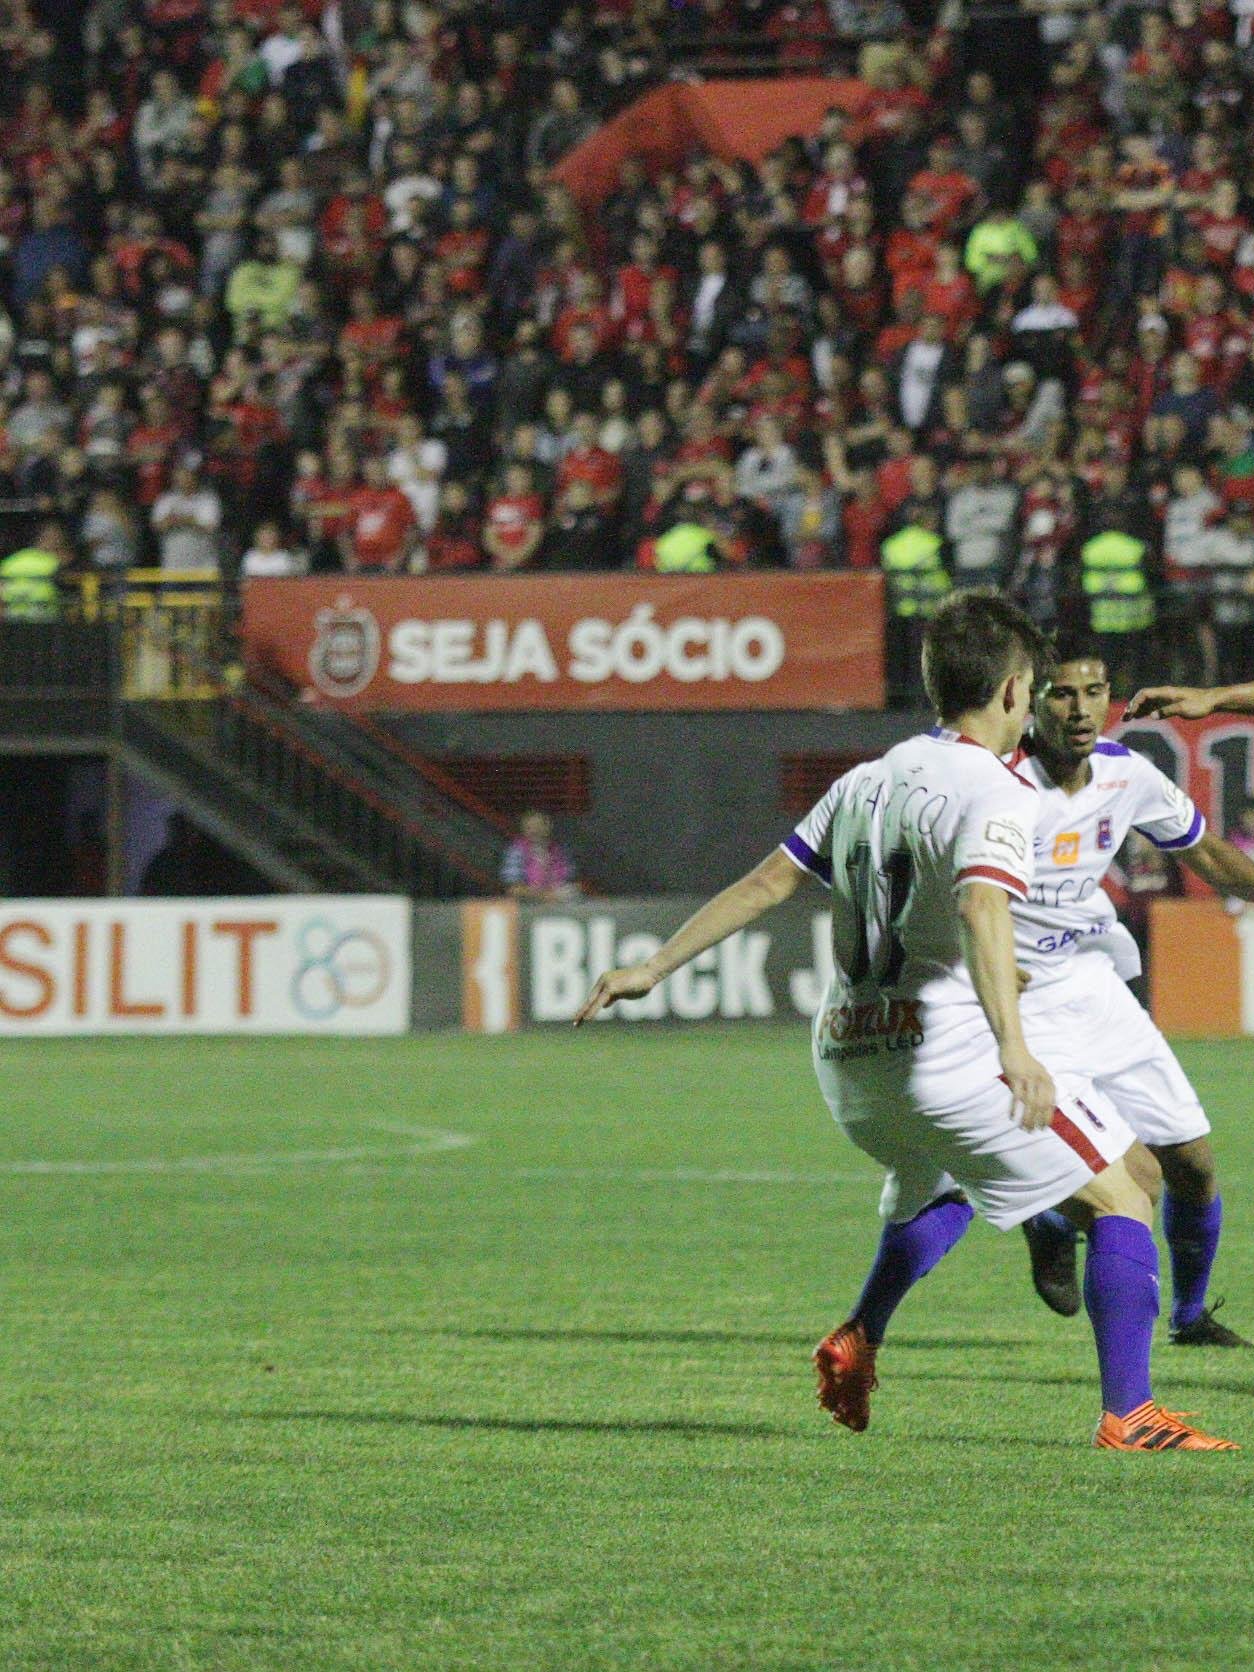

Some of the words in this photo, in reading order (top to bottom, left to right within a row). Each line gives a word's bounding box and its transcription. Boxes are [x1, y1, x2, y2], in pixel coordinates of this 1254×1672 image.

[388, 618, 557, 683] SEJA
[568, 603, 786, 683] SÓCIO
[0, 917, 279, 1020] SILIT
[530, 915, 774, 1020] Black
